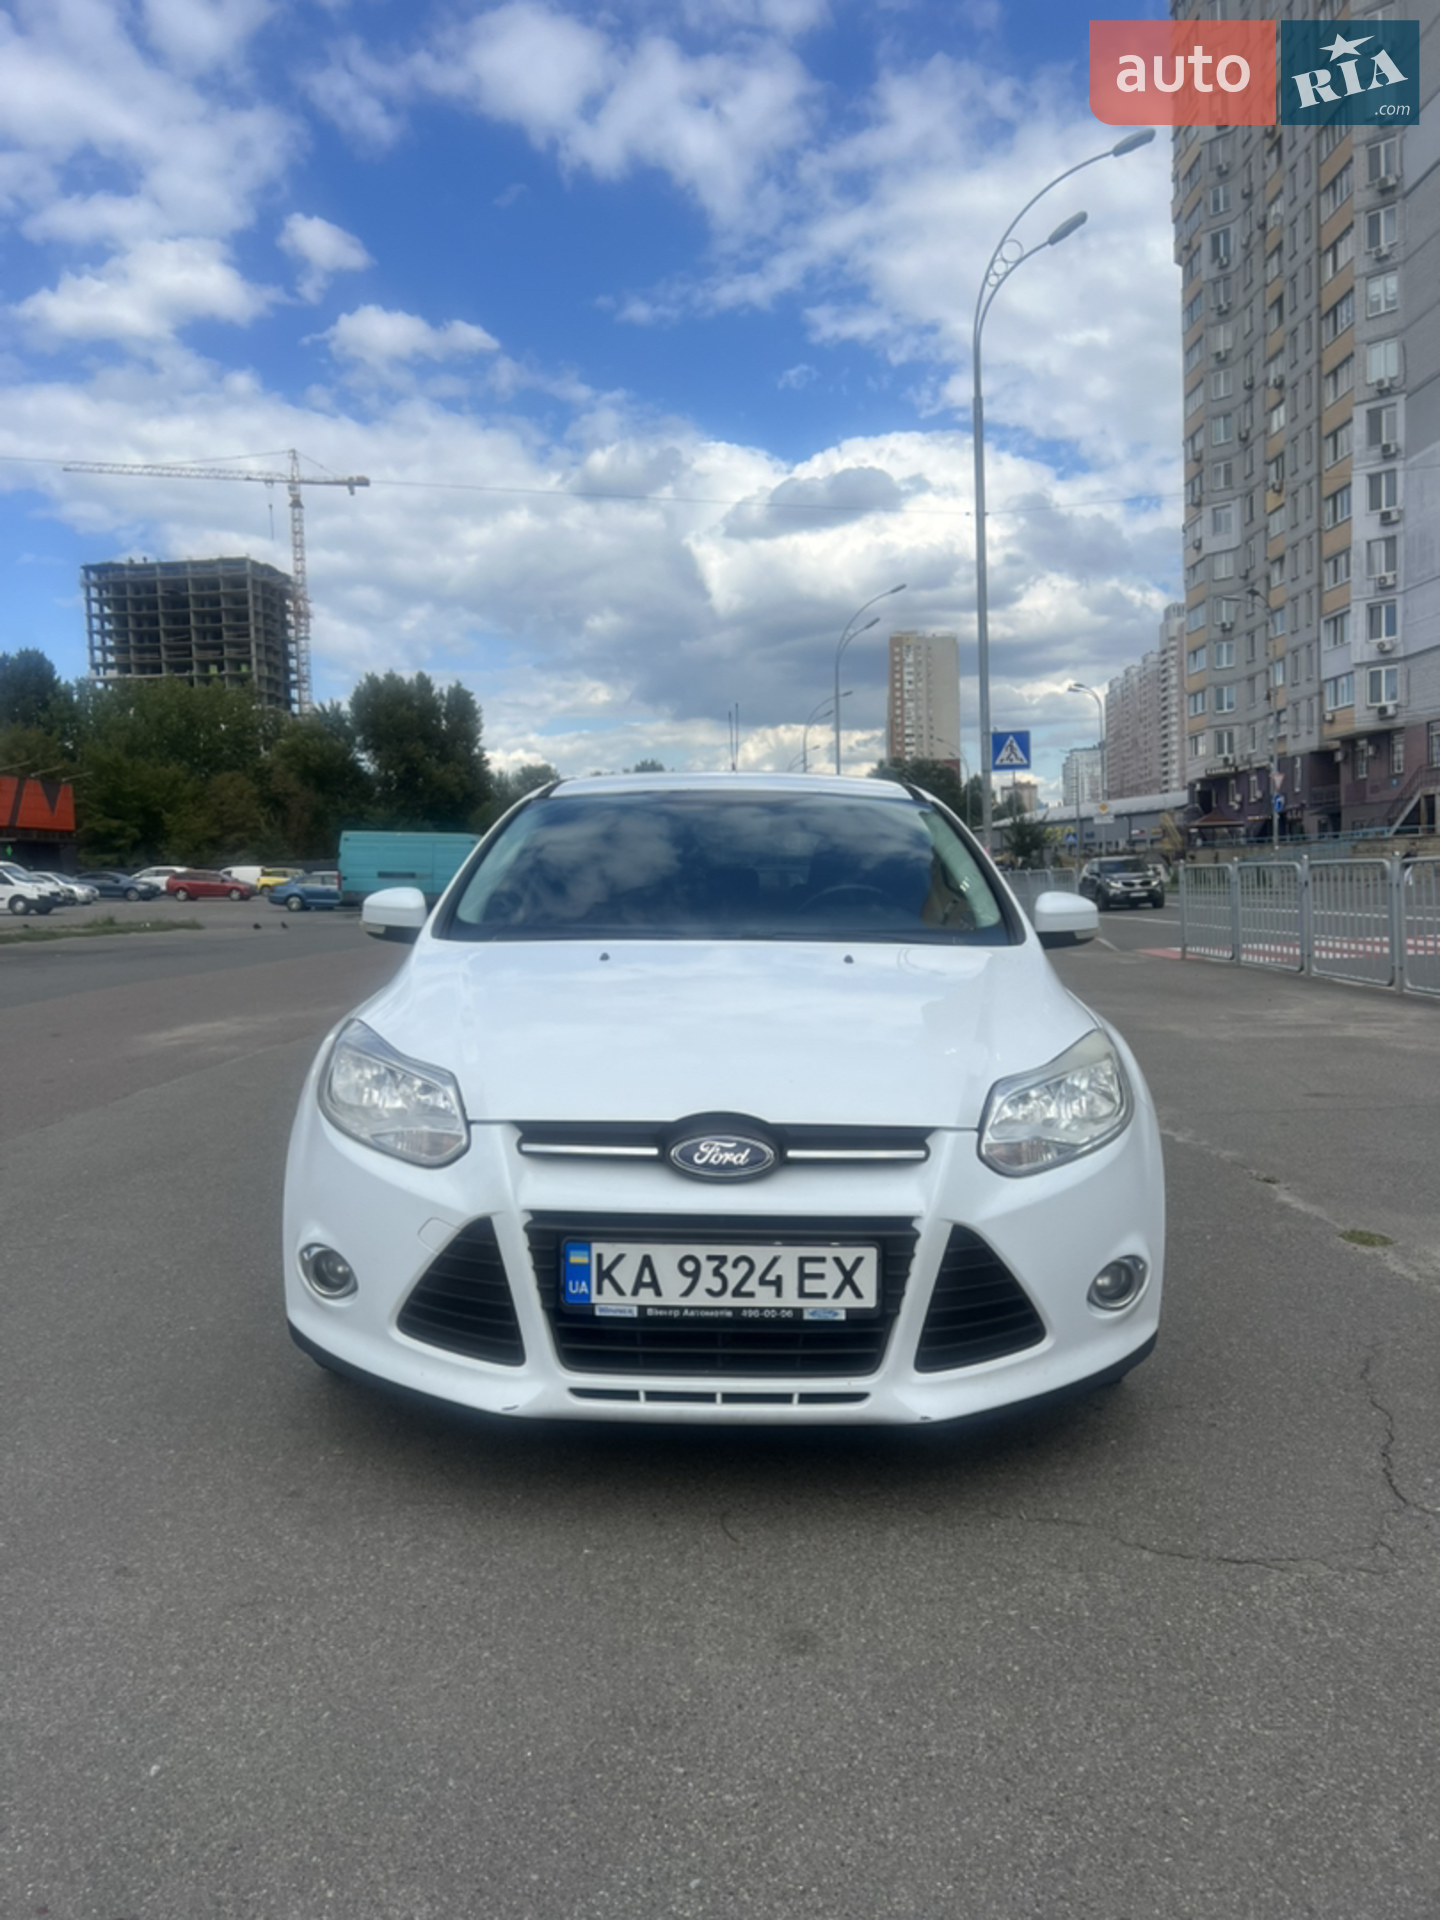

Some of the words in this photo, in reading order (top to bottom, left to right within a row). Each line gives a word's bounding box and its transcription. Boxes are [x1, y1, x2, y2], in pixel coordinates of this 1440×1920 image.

[693, 1140, 751, 1165] Ford
[568, 1280, 589, 1295] UA
[595, 1252, 663, 1297] KA
[677, 1254, 783, 1298] 9324
[797, 1255, 865, 1299] EX
